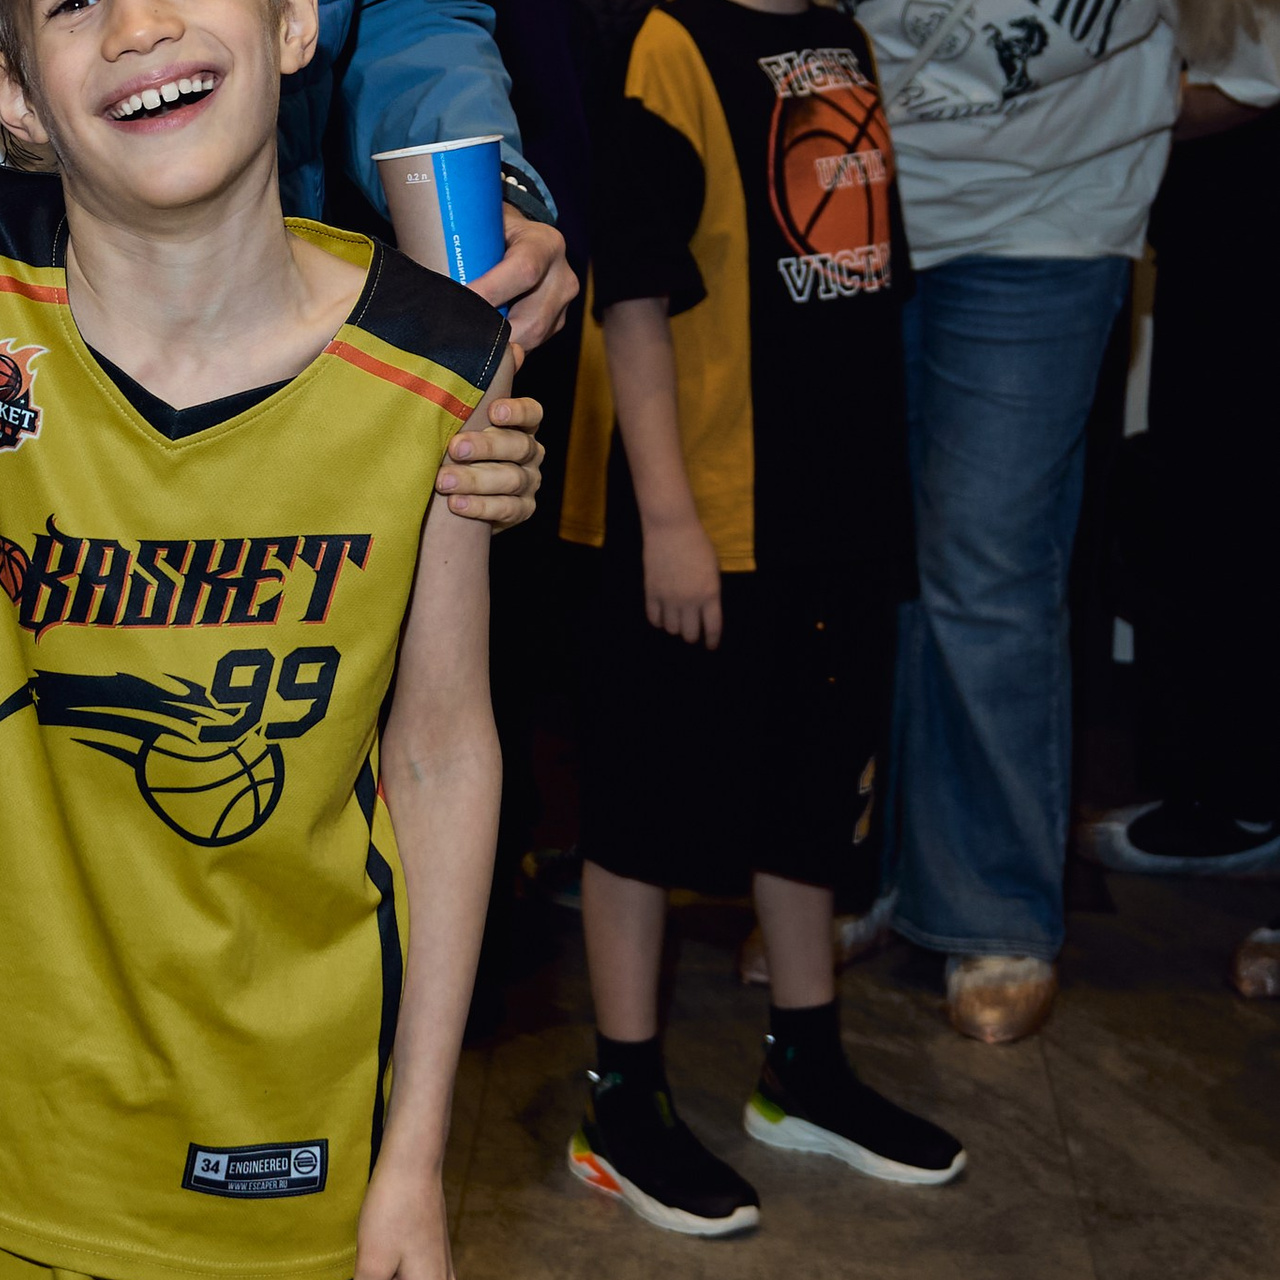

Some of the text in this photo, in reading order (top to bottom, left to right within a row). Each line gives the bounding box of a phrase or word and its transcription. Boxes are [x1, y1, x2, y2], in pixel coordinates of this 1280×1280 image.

[758, 48, 869, 99] FIGHT
[407, 172, 419, 182] 0.2
[199, 646, 341, 743] 99
[201, 1157, 289, 1175] 34 ENGINEERED
